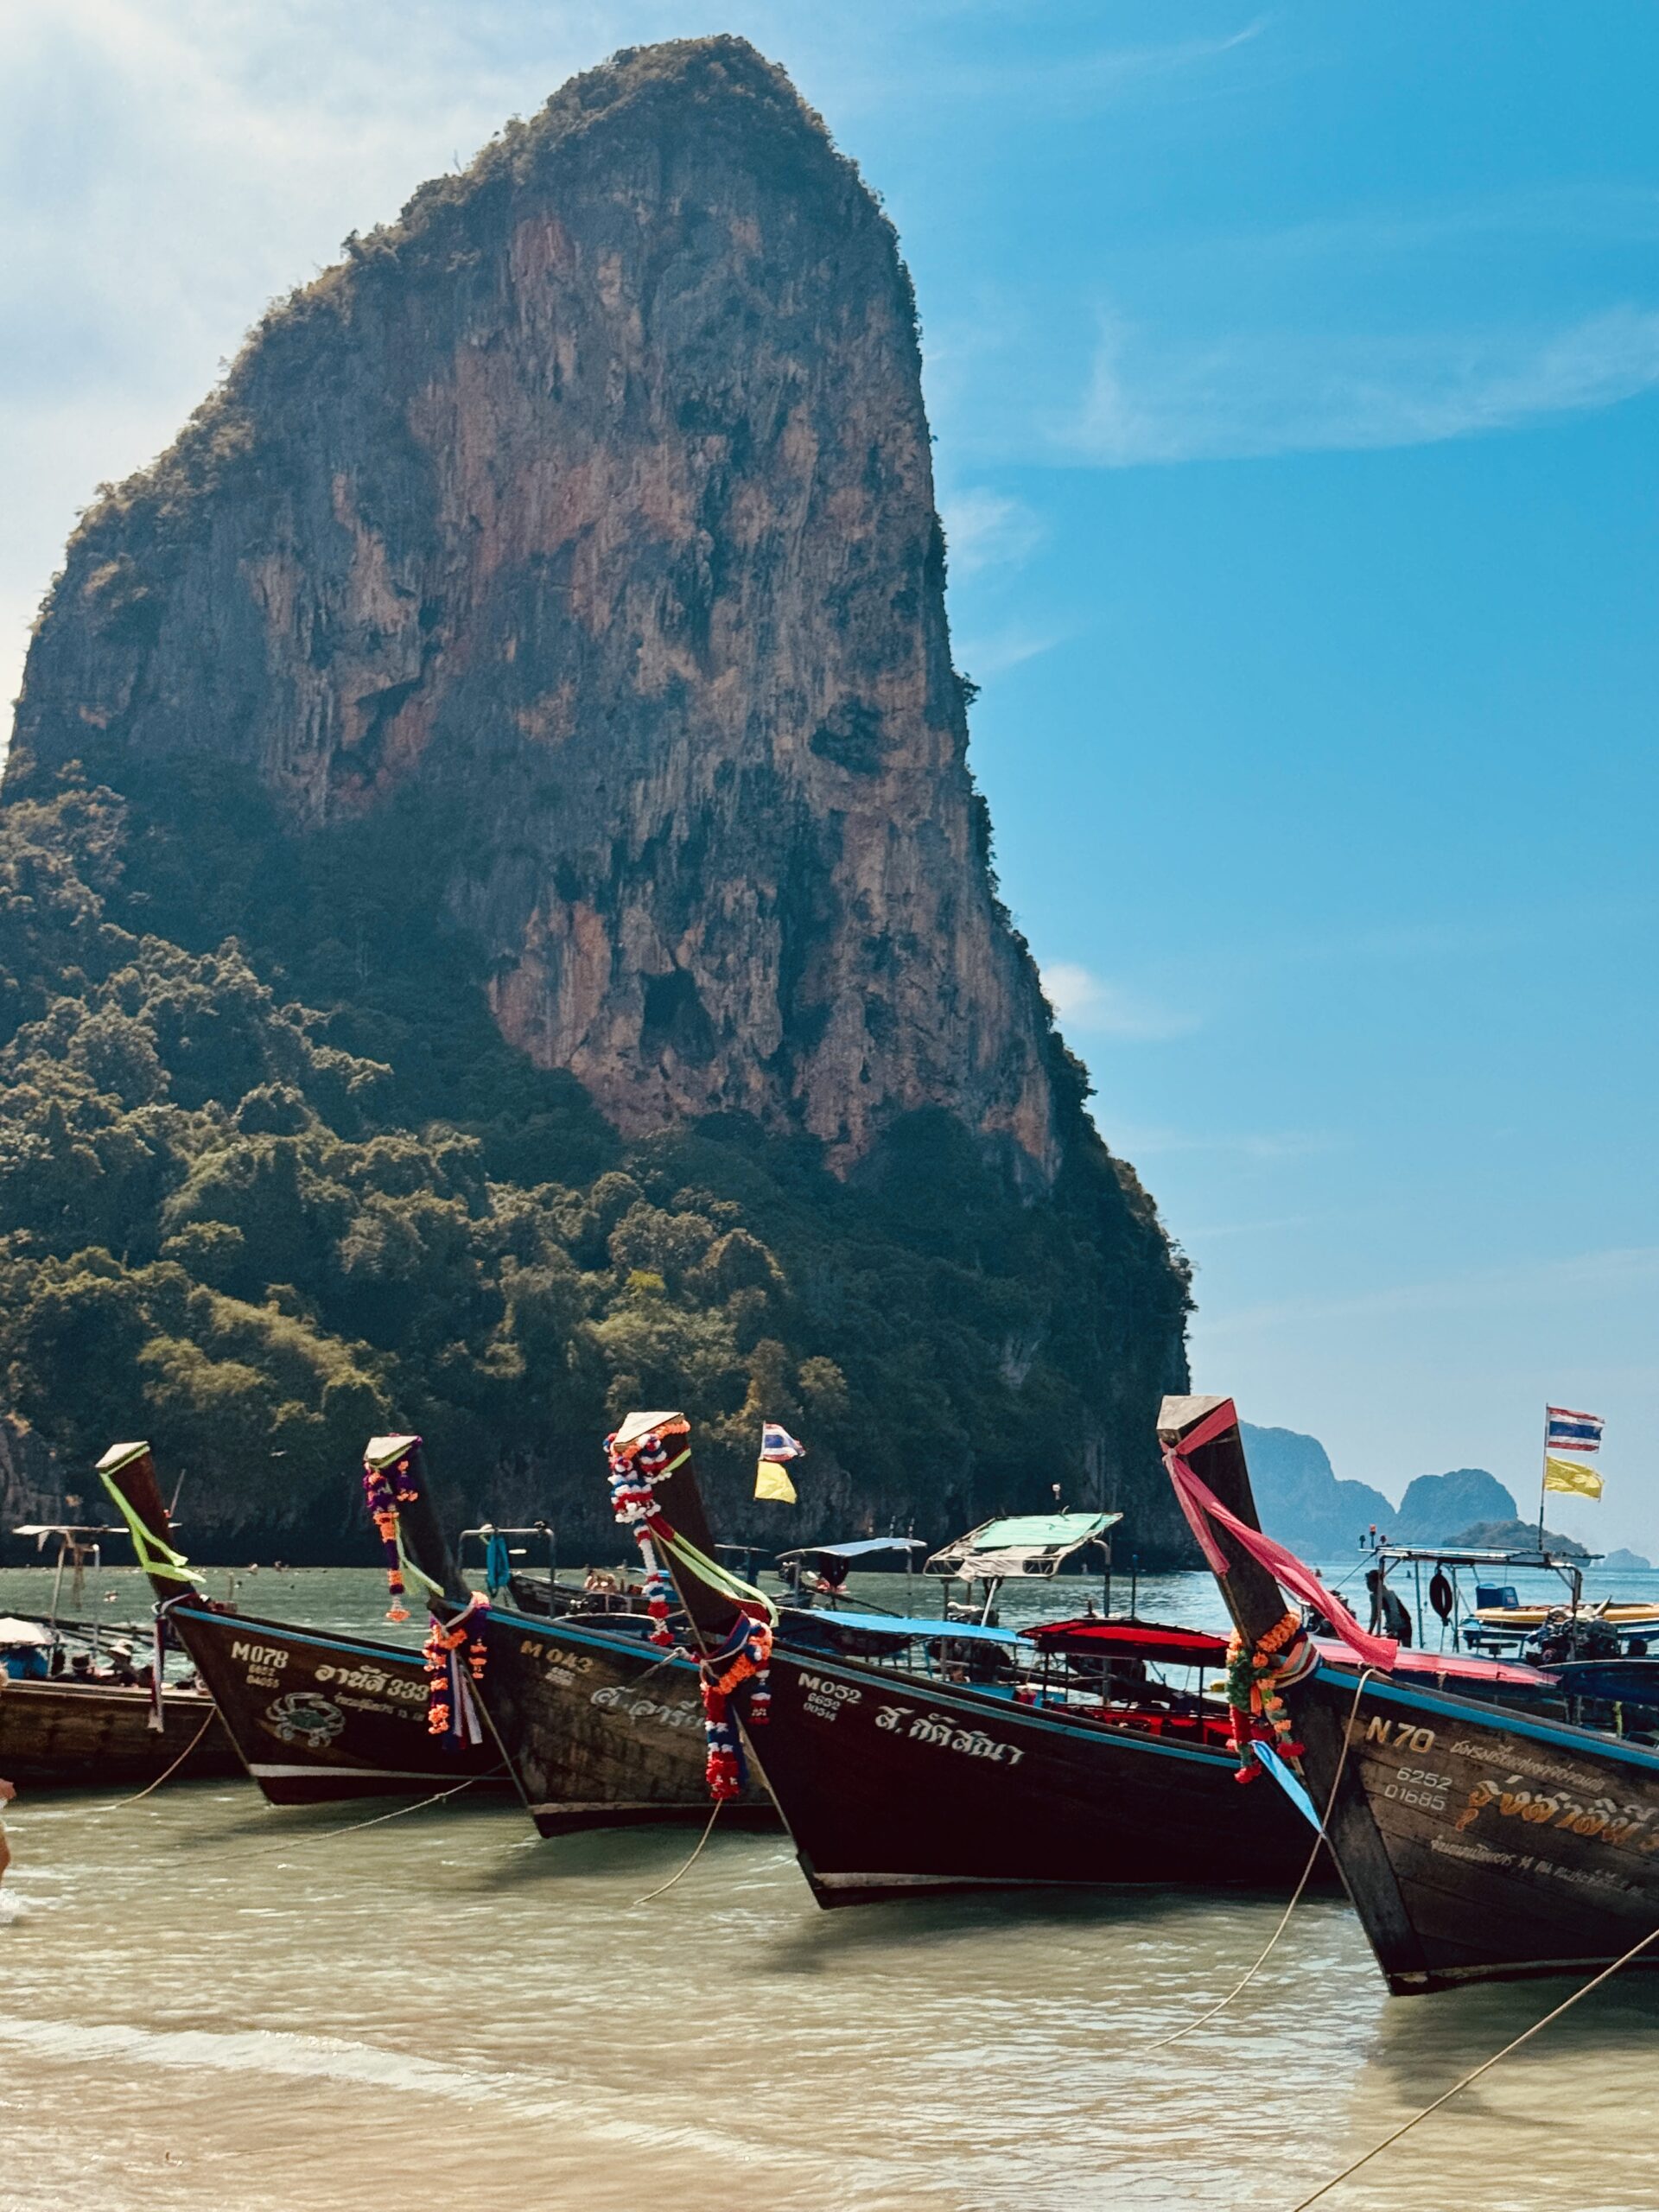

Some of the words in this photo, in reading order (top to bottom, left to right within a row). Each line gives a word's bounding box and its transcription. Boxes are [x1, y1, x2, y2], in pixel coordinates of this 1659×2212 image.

[231, 1641, 289, 1669] M078
[387, 1679, 429, 1701] 333
[798, 1672, 862, 1705] M052
[1396, 1767, 1452, 1791] 6252
[1384, 1784, 1446, 1811] 01685
